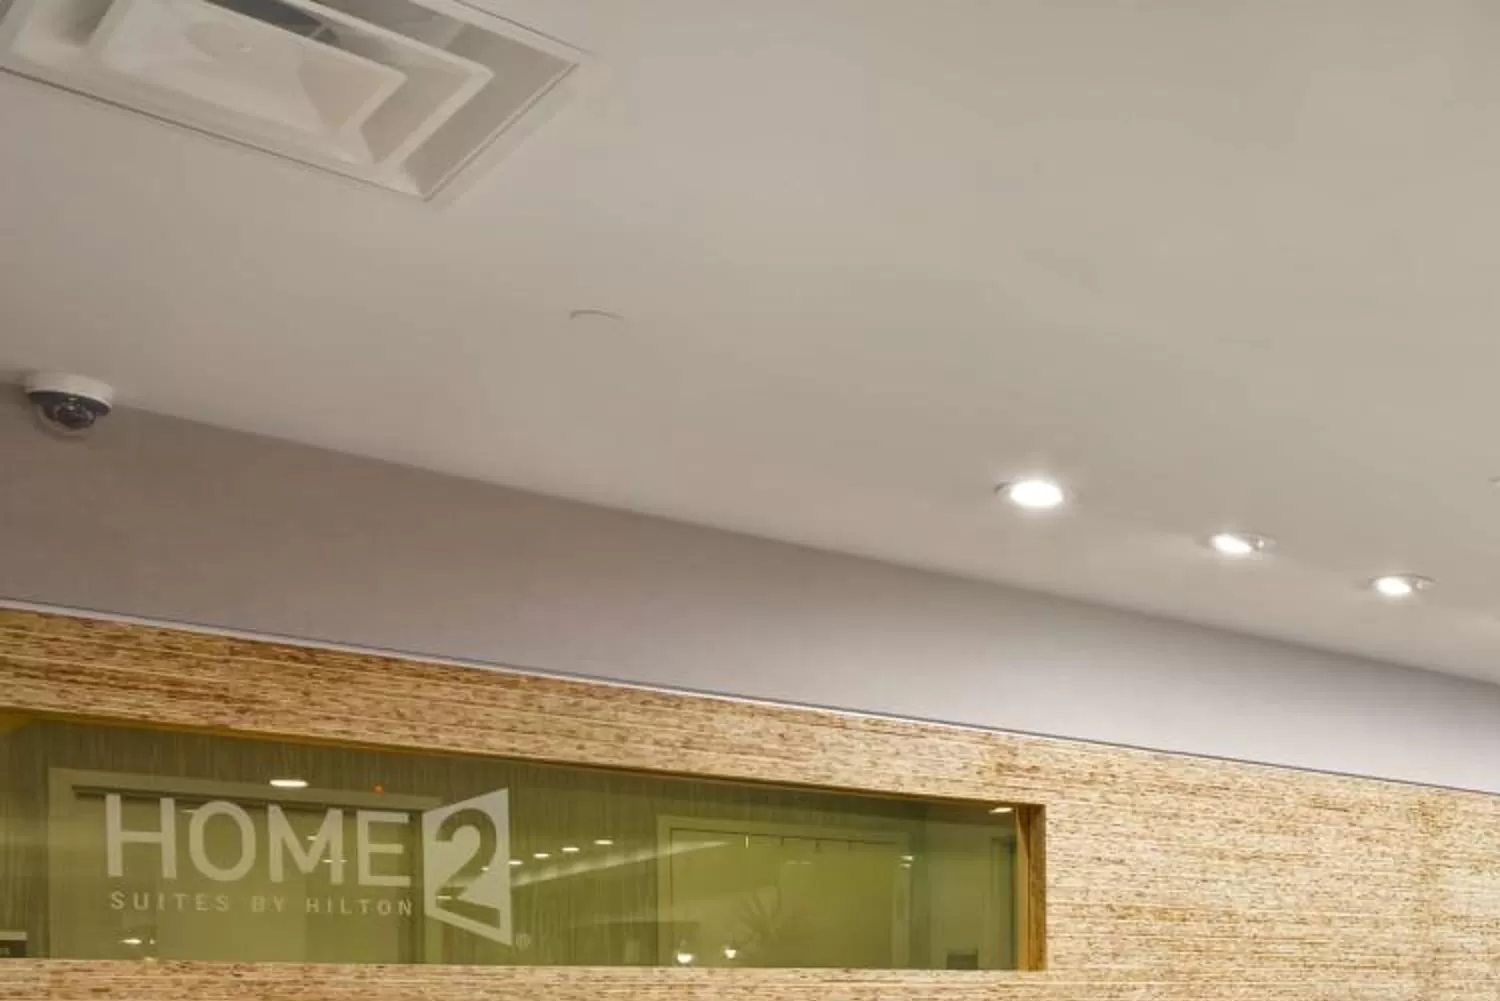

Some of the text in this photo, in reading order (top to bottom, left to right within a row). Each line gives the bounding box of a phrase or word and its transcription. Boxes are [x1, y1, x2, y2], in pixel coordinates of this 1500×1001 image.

[111, 890, 413, 917] SUITES BY HILTON
